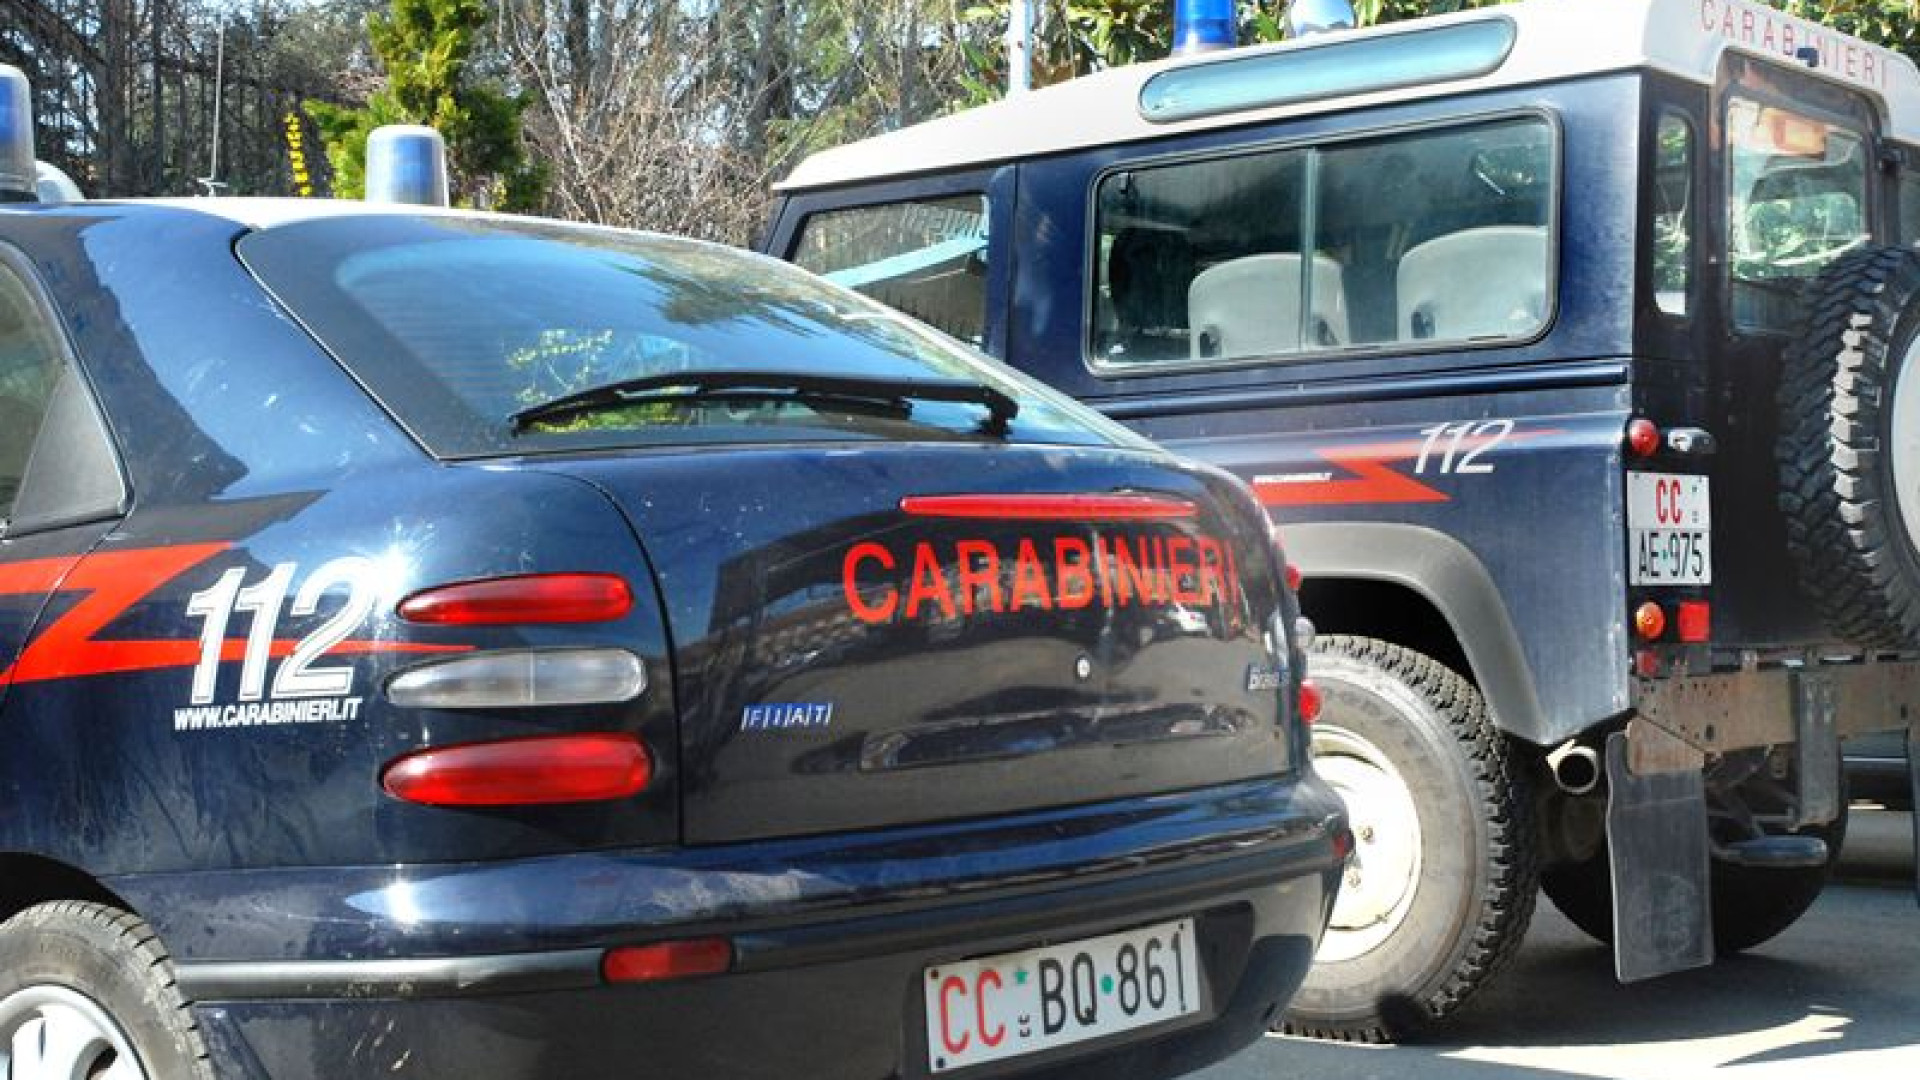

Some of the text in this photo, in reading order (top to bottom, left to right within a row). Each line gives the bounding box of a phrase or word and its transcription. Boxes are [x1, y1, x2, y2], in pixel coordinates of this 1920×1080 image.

[1414, 419, 1515, 474] 112
[1656, 479, 1682, 524] CC
[842, 535, 1241, 625] CARABINIERI
[186, 556, 377, 705] 112
[940, 970, 1005, 1054] CC
